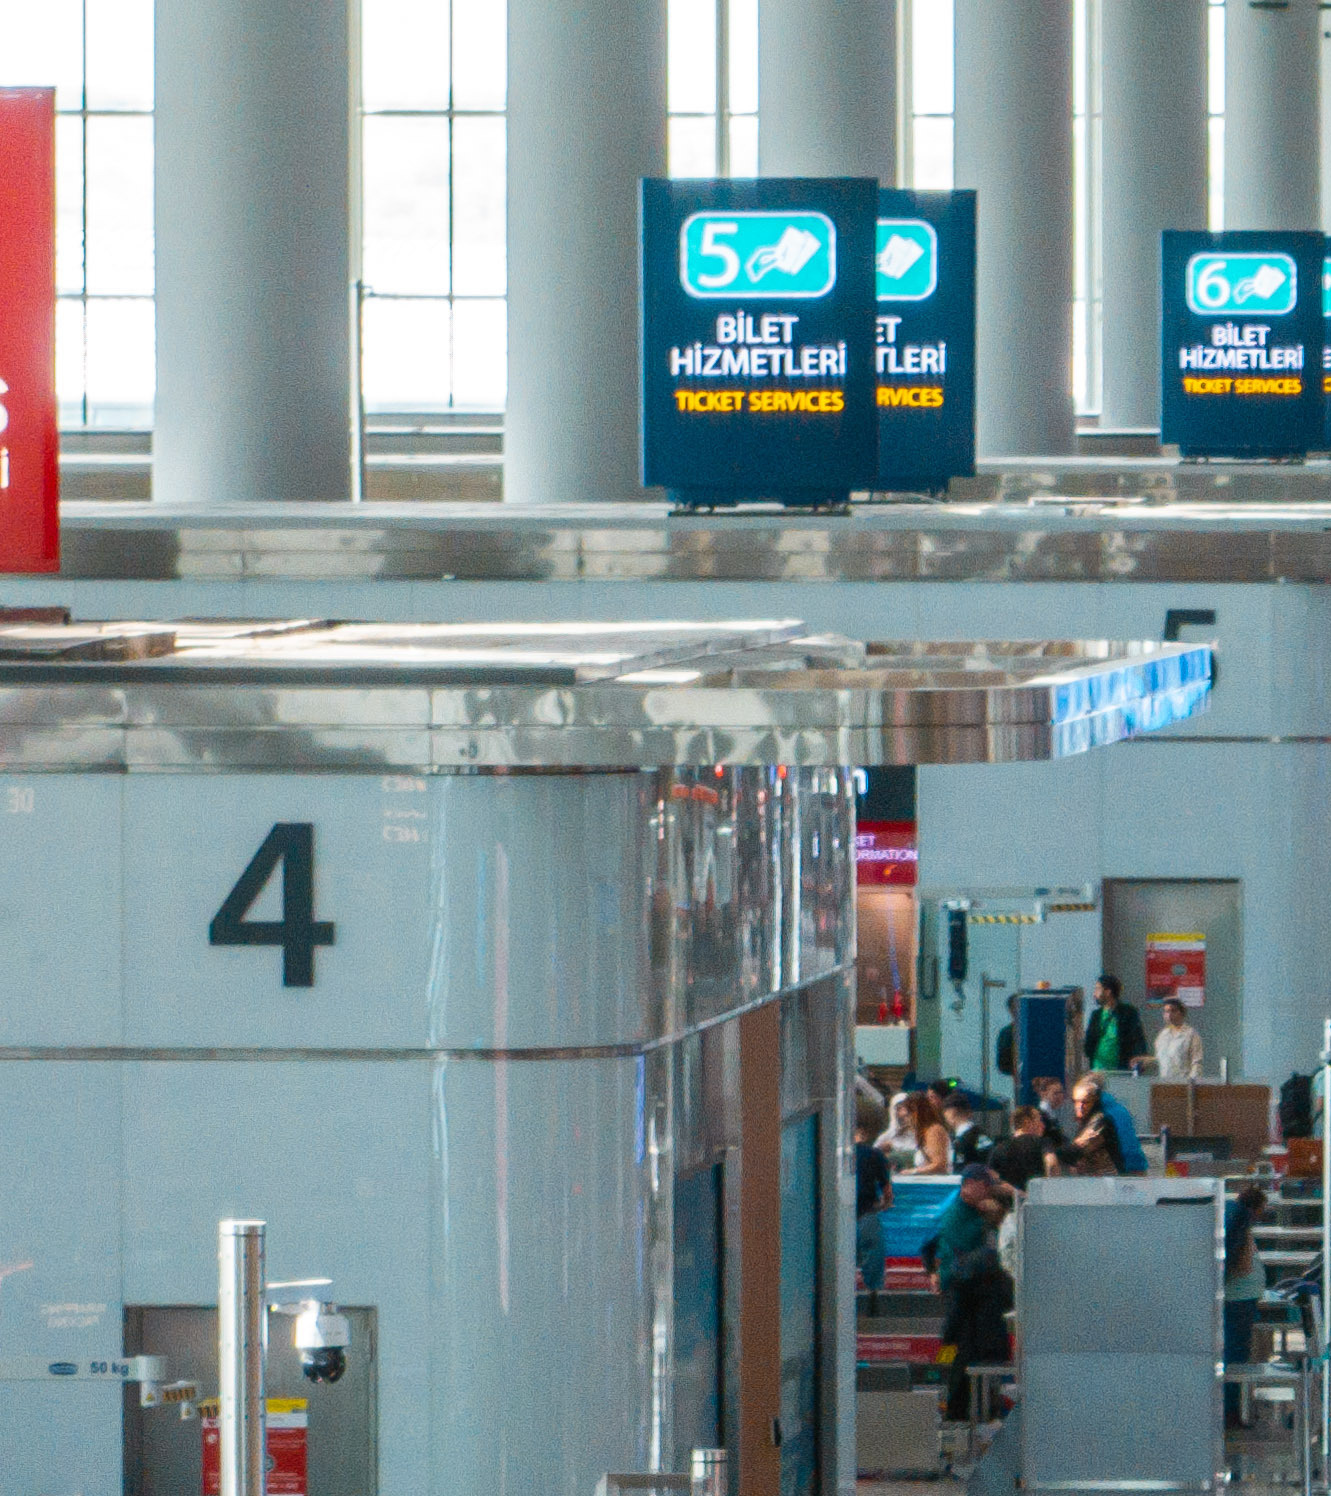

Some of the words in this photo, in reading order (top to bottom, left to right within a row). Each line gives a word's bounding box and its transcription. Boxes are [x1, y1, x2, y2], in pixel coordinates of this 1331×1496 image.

[697, 221, 741, 288] 5
[1197, 261, 1231, 308] 6
[716, 309, 800, 344] BİLET
[1210, 322, 1271, 347] BİLET
[669, 341, 848, 377] HİZMETLERİ
[1179, 345, 1304, 370] HİZMETLERİ
[674, 390, 745, 413] TICKET
[748, 390, 845, 414] SERVICES
[1182, 377, 1233, 394] TICKET
[1234, 377, 1303, 395] SERVICES
[208, 821, 336, 988] 4
